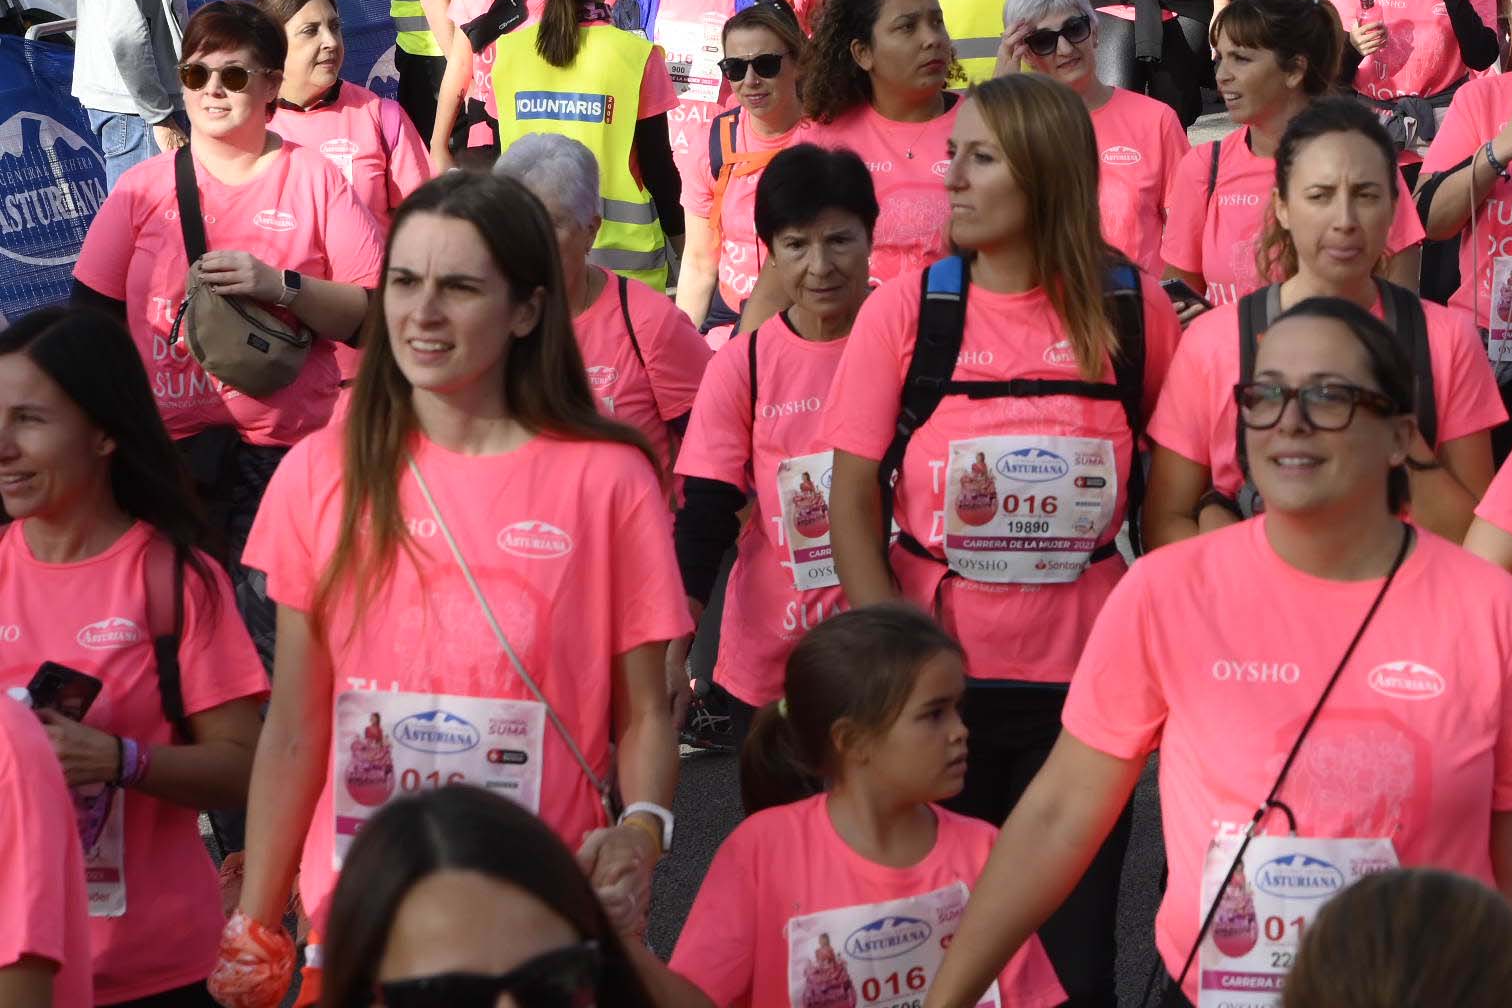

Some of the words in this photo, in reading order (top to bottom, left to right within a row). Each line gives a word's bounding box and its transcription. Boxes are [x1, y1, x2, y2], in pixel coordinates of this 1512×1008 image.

[60, 156, 94, 174] ECHERA
[761, 396, 821, 420] OYSHO
[1001, 460, 1064, 475] ASTURIANA
[1073, 455, 1105, 466] SUMA
[1003, 494, 1058, 515] 016
[1008, 520, 1050, 535] 19890
[504, 530, 568, 552] ASTURIANA
[963, 539, 1008, 549] CARRERA
[1009, 539, 1025, 549] DE
[1026, 539, 1038, 550] LA
[1038, 540, 1072, 550] MUJER
[808, 547, 833, 559] CARR
[808, 565, 836, 579] OYS
[957, 557, 1009, 573] OYSHO
[1211, 659, 1301, 685] OYSHO
[1373, 671, 1442, 694] ASTURIANA
[401, 724, 474, 748] ASTURIANA
[487, 723, 529, 738] SUMA
[1260, 871, 1337, 888] ASTURIANA
[1264, 915, 1307, 942] 01
[851, 929, 926, 956] ASTURIANA
[862, 965, 927, 1003] 016
[1221, 974, 1275, 988] CARRERA
